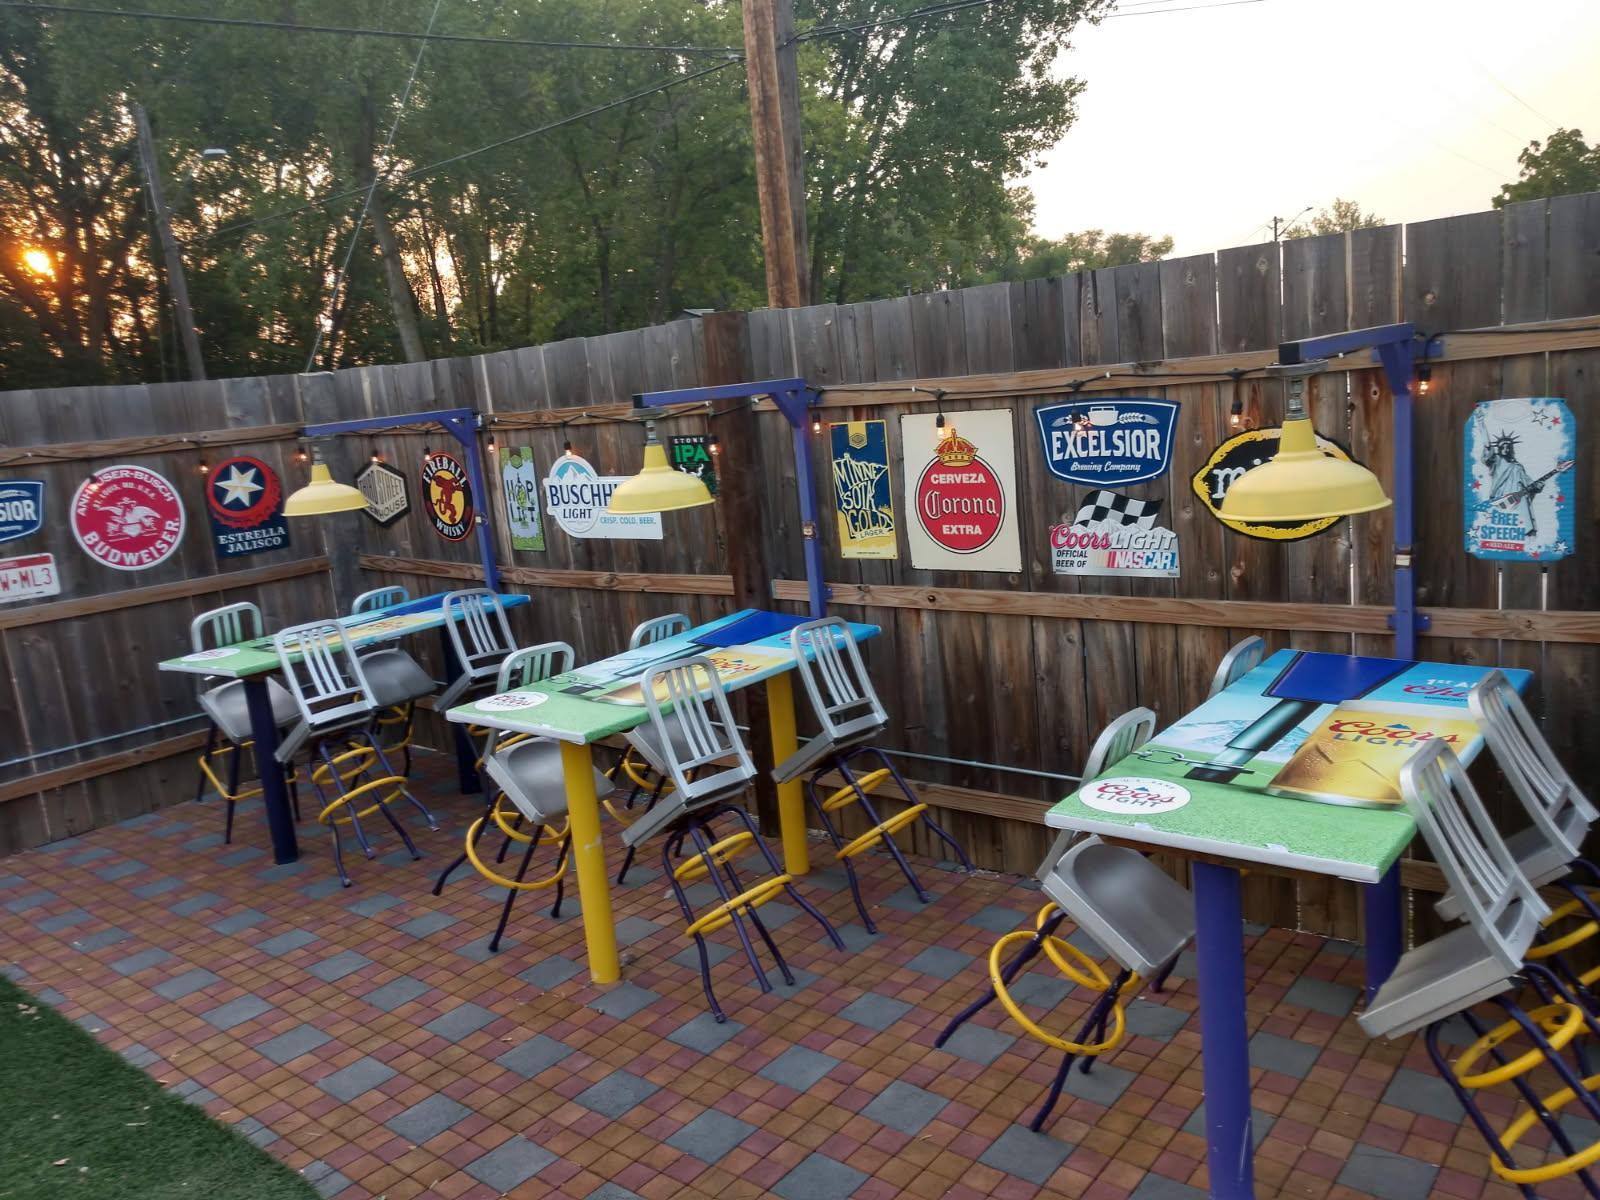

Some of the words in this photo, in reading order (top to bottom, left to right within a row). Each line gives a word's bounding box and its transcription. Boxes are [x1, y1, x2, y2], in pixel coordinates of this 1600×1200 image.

[673, 444, 710, 463] IPA
[1051, 429, 1162, 462] EXCELSIOR
[423, 456, 467, 484] FIREBALL
[1070, 461, 1103, 472] Brewing
[1104, 461, 1141, 472] Company
[930, 473, 986, 485] CERVEZA
[77, 469, 175, 517] ANHUSER-BUSCH
[924, 490, 999, 519] Corona
[563, 508, 593, 519] LIGHT
[848, 508, 894, 534] GOLD
[1491, 509, 1519, 526] FREE
[217, 526, 286, 545] ESTRELLA
[860, 528, 885, 539] LAGER
[942, 524, 983, 535] EXTRA
[1051, 523, 1112, 550] Coors
[1110, 533, 1177, 550] LIGHT
[1480, 525, 1526, 541] SPEECH
[227, 537, 282, 554] JALISCO
[1056, 549, 1088, 559] OFFICIAL
[1055, 560, 1074, 568] BEER
[1076, 560, 1088, 568] OF
[1328, 719, 1460, 744] Coors
[1333, 732, 1418, 748] LIGH
[1096, 793, 1161, 808] LIGHT
[1097, 782, 1176, 804] Coors
